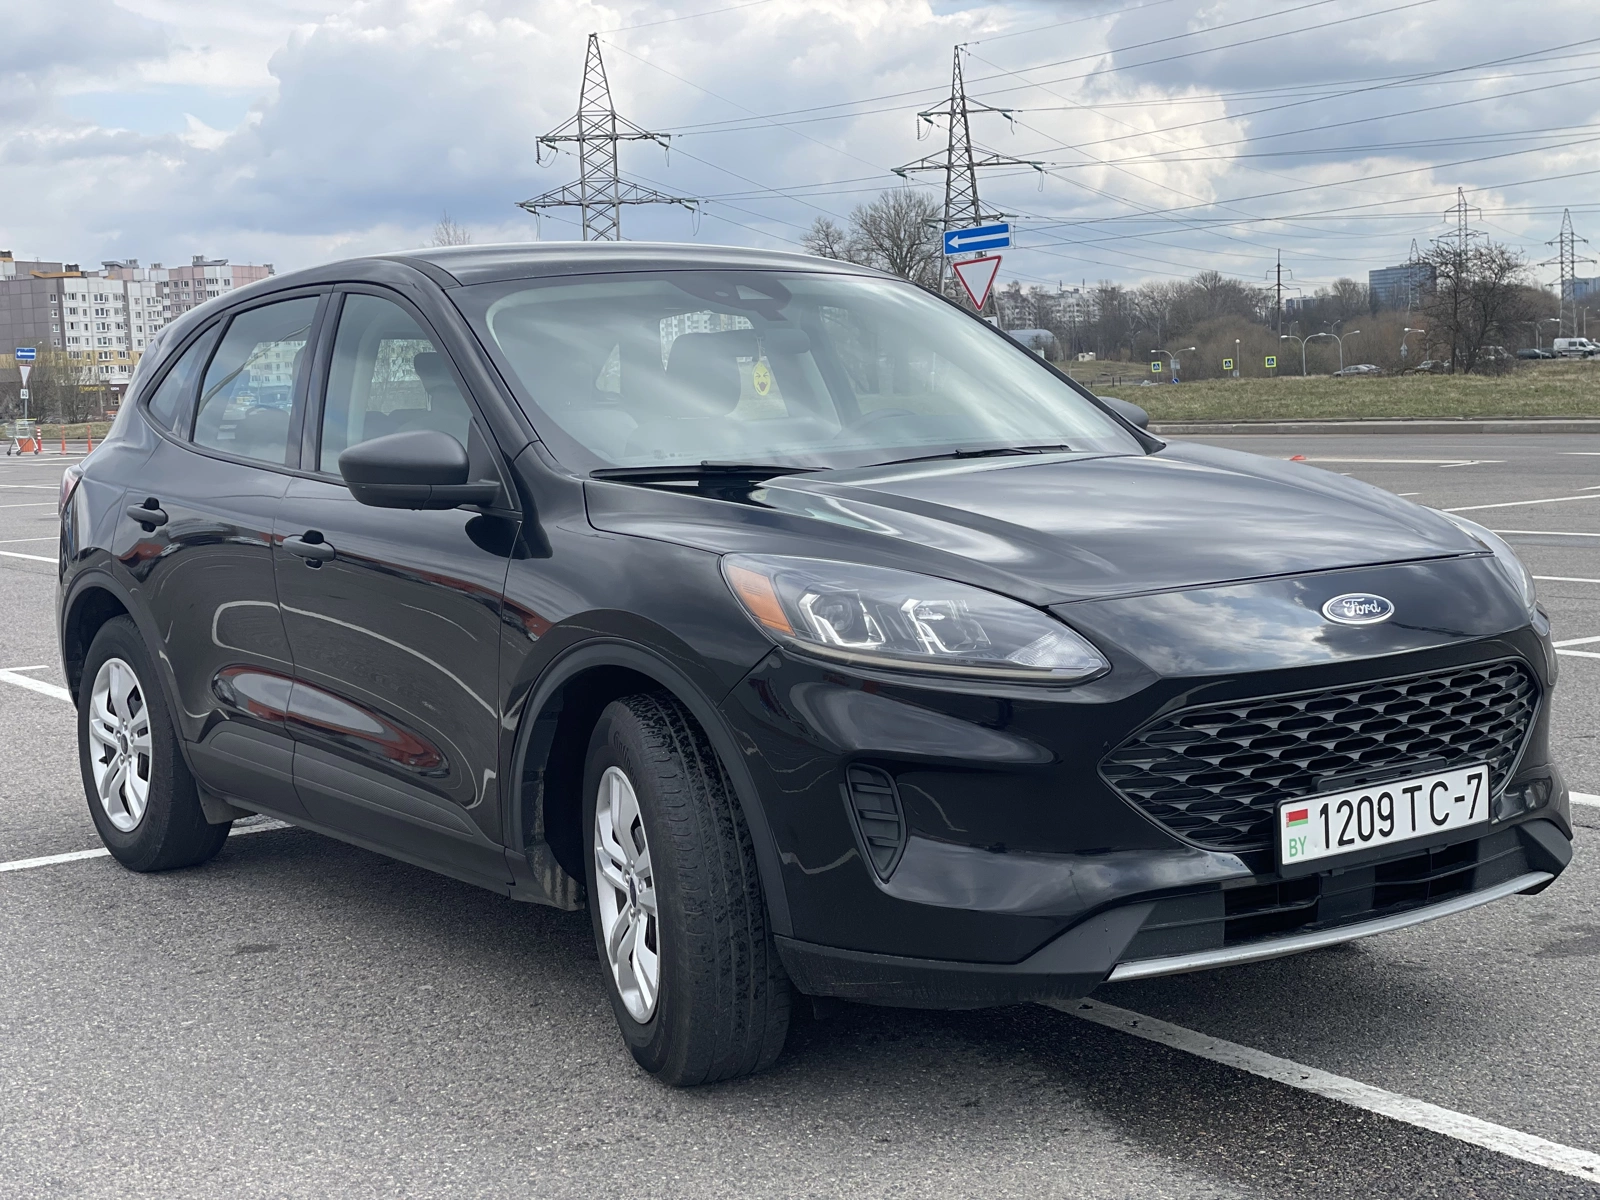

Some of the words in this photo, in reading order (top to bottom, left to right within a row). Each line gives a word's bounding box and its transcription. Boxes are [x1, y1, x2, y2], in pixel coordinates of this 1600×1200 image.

[1342, 597, 1381, 617] Ford
[1319, 791, 1395, 849] 1209
[1289, 835, 1307, 857] BY
